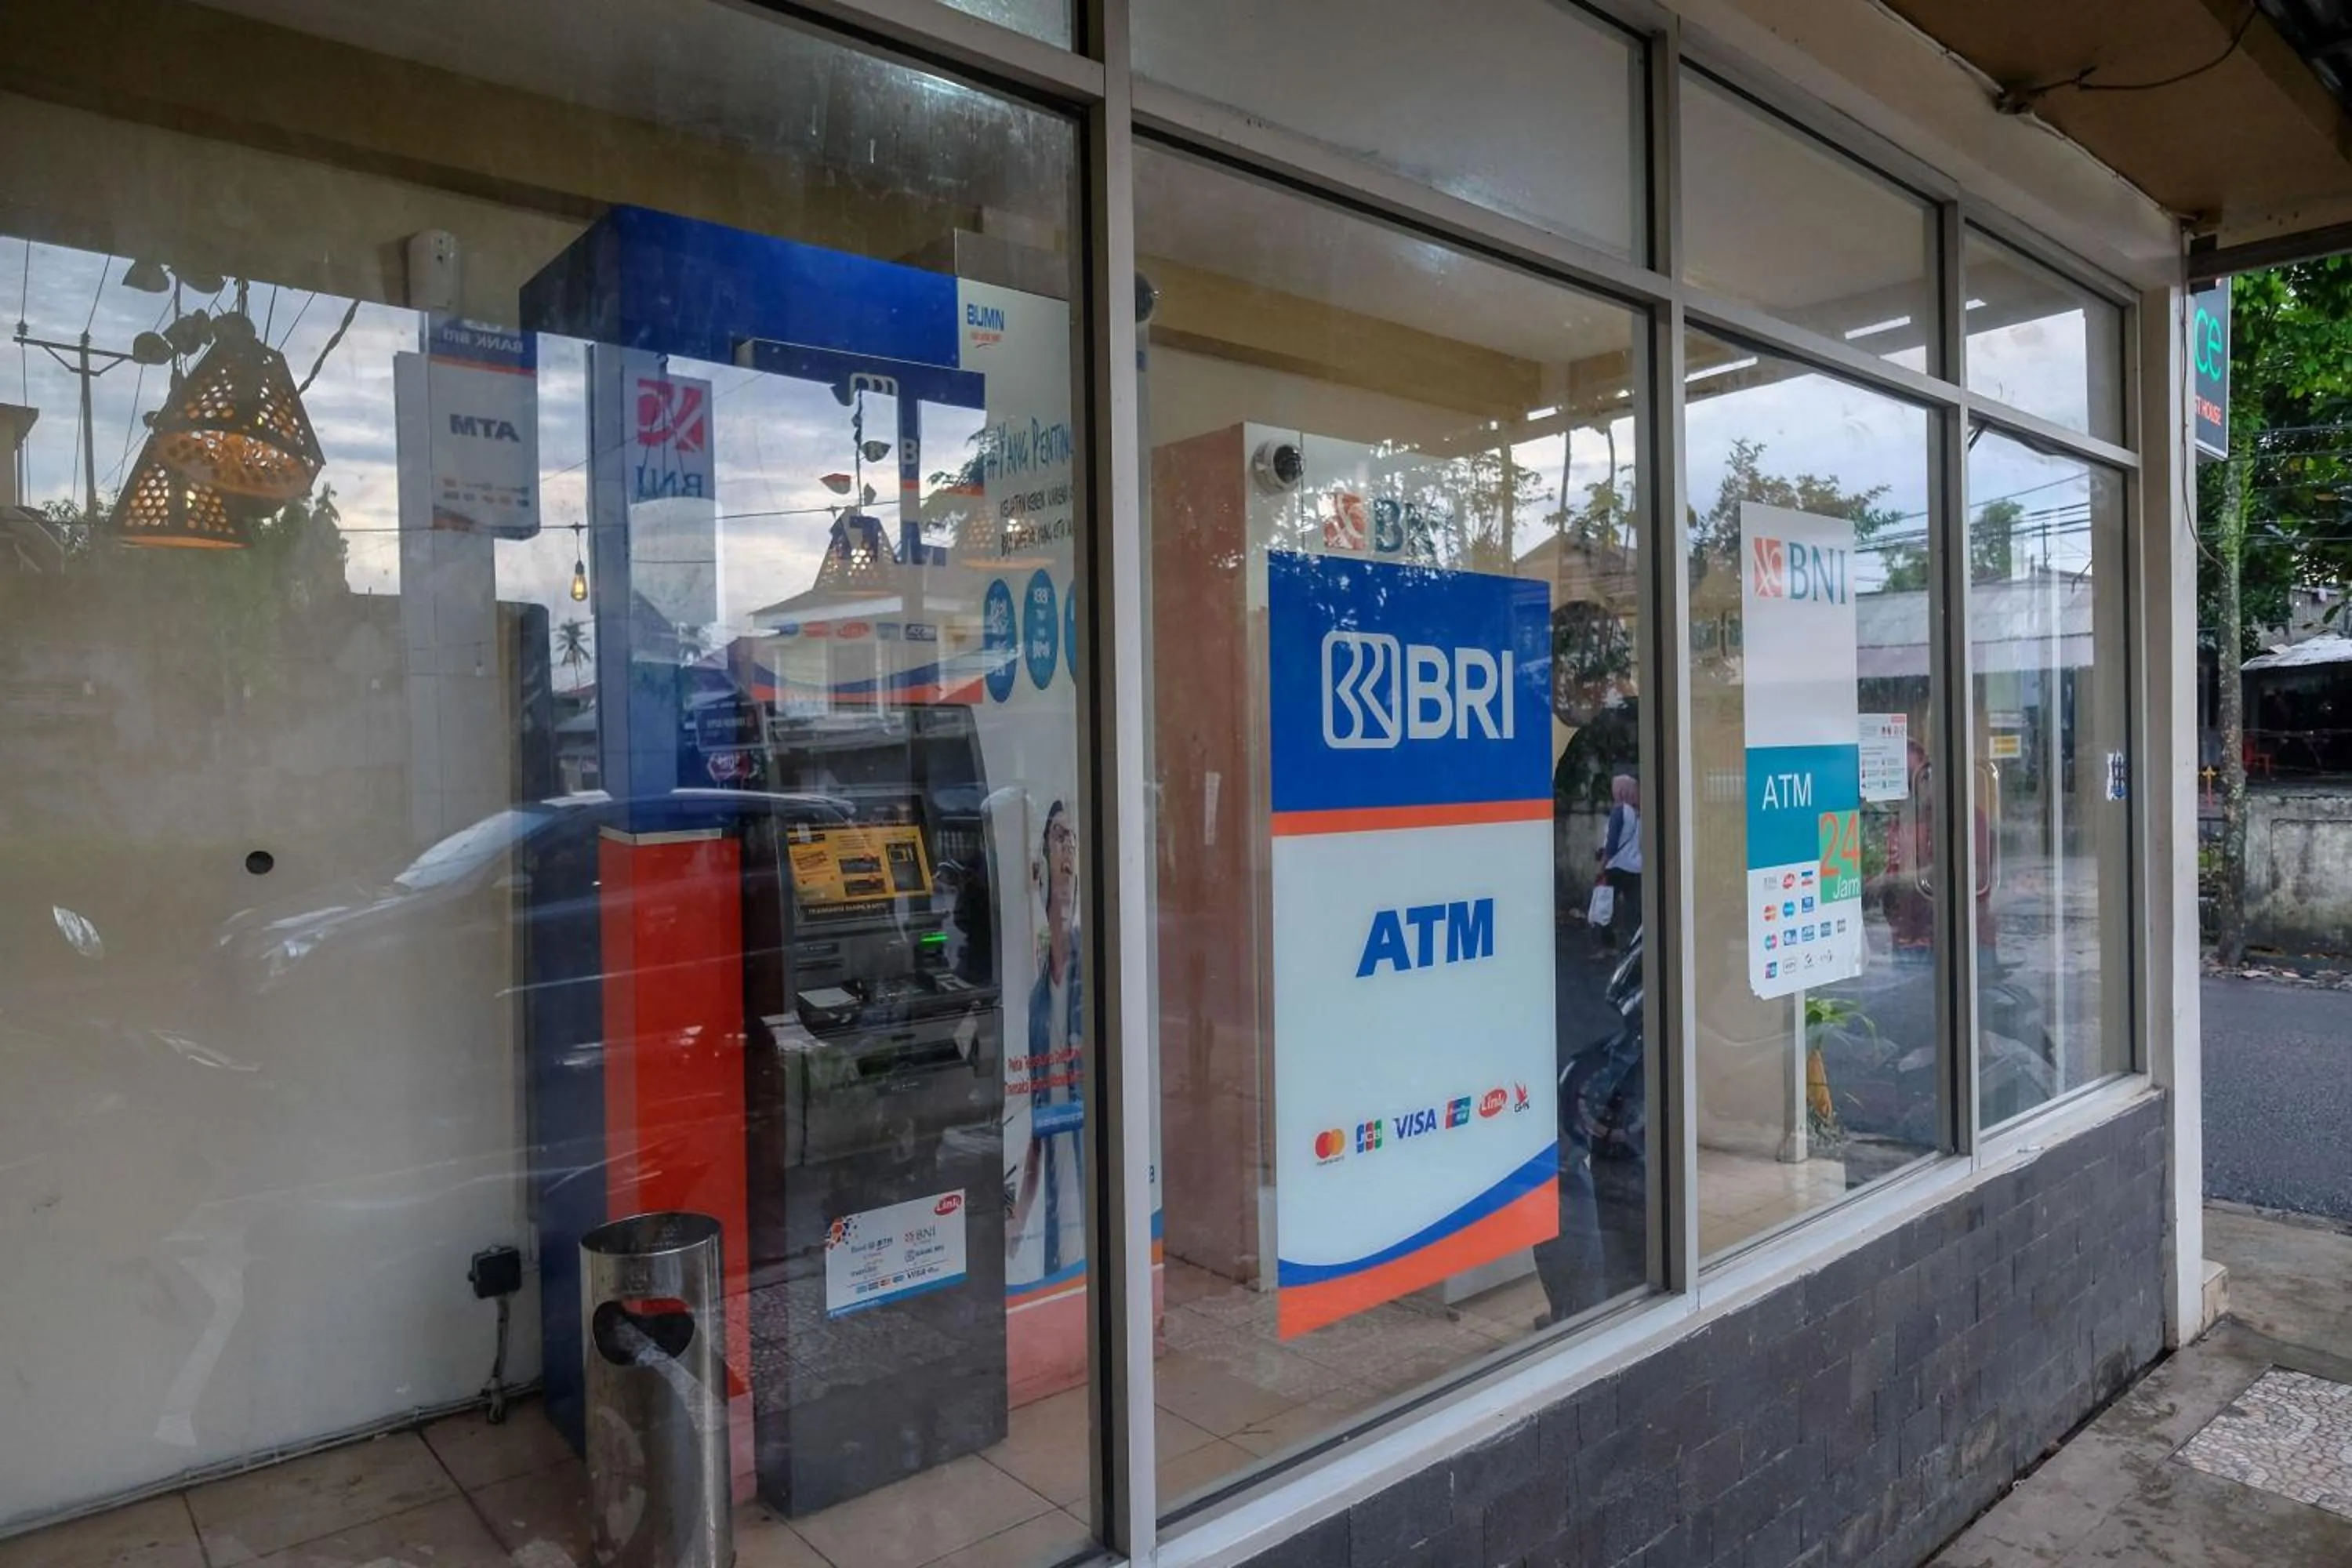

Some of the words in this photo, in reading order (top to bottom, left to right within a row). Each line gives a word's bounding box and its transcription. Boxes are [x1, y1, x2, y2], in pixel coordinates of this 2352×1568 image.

[967, 303, 1004, 332] BUMN
[1374, 498, 1445, 560] BN
[1788, 541, 1846, 605] BNI
[1406, 644, 1514, 739] BRI
[1762, 772, 1813, 811] ATM
[1820, 812, 1860, 877] 24
[1833, 876, 1860, 900] Jam
[1356, 898, 1494, 978] ATM
[1392, 1109, 1437, 1140] VISA
